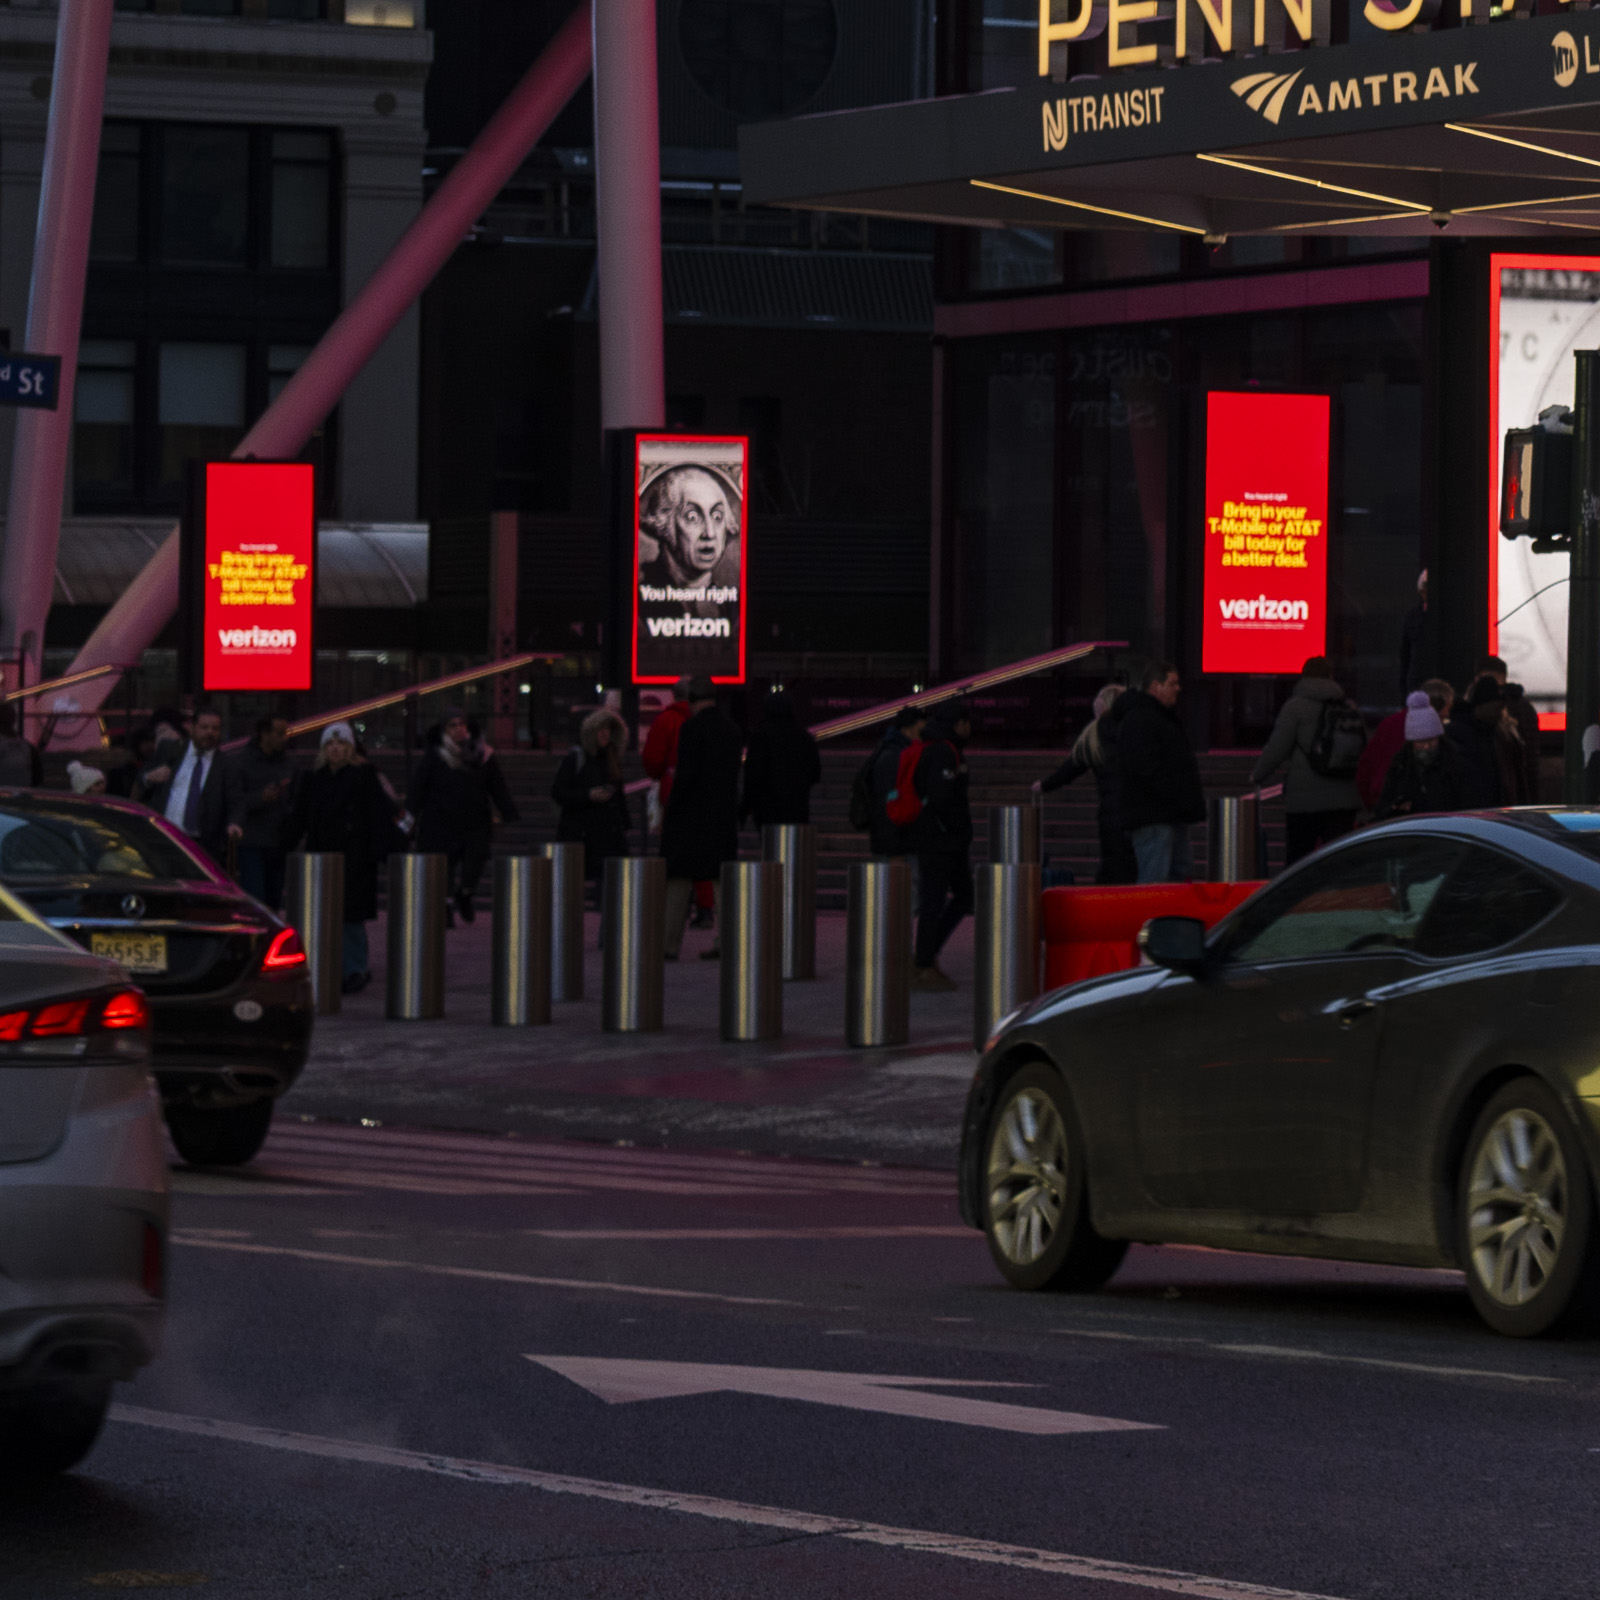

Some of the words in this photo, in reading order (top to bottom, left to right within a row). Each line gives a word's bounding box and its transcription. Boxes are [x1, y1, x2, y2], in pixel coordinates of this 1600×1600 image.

[1298, 61, 1480, 116] AMTRAK
[1068, 86, 1165, 135] TRANSIT
[18, 367, 45, 396] St
[1223, 501, 1260, 521] Bring
[1261, 502, 1275, 519] in
[1275, 506, 1307, 521] your
[1208, 517, 1267, 535] T-Mobile
[1268, 522, 1283, 535] or
[1284, 520, 1322, 536] AT&T
[1224, 534, 1245, 550] bill
[1246, 534, 1285, 553] today
[1285, 535, 1306, 551] for
[1222, 552, 1231, 566] a
[1232, 550, 1274, 567] better
[639, 584, 666, 601] You
[666, 584, 706, 601] heard
[706, 586, 738, 604] right
[1219, 594, 1309, 621] verizon
[218, 625, 297, 648] verizon
[646, 612, 730, 638] verizon
